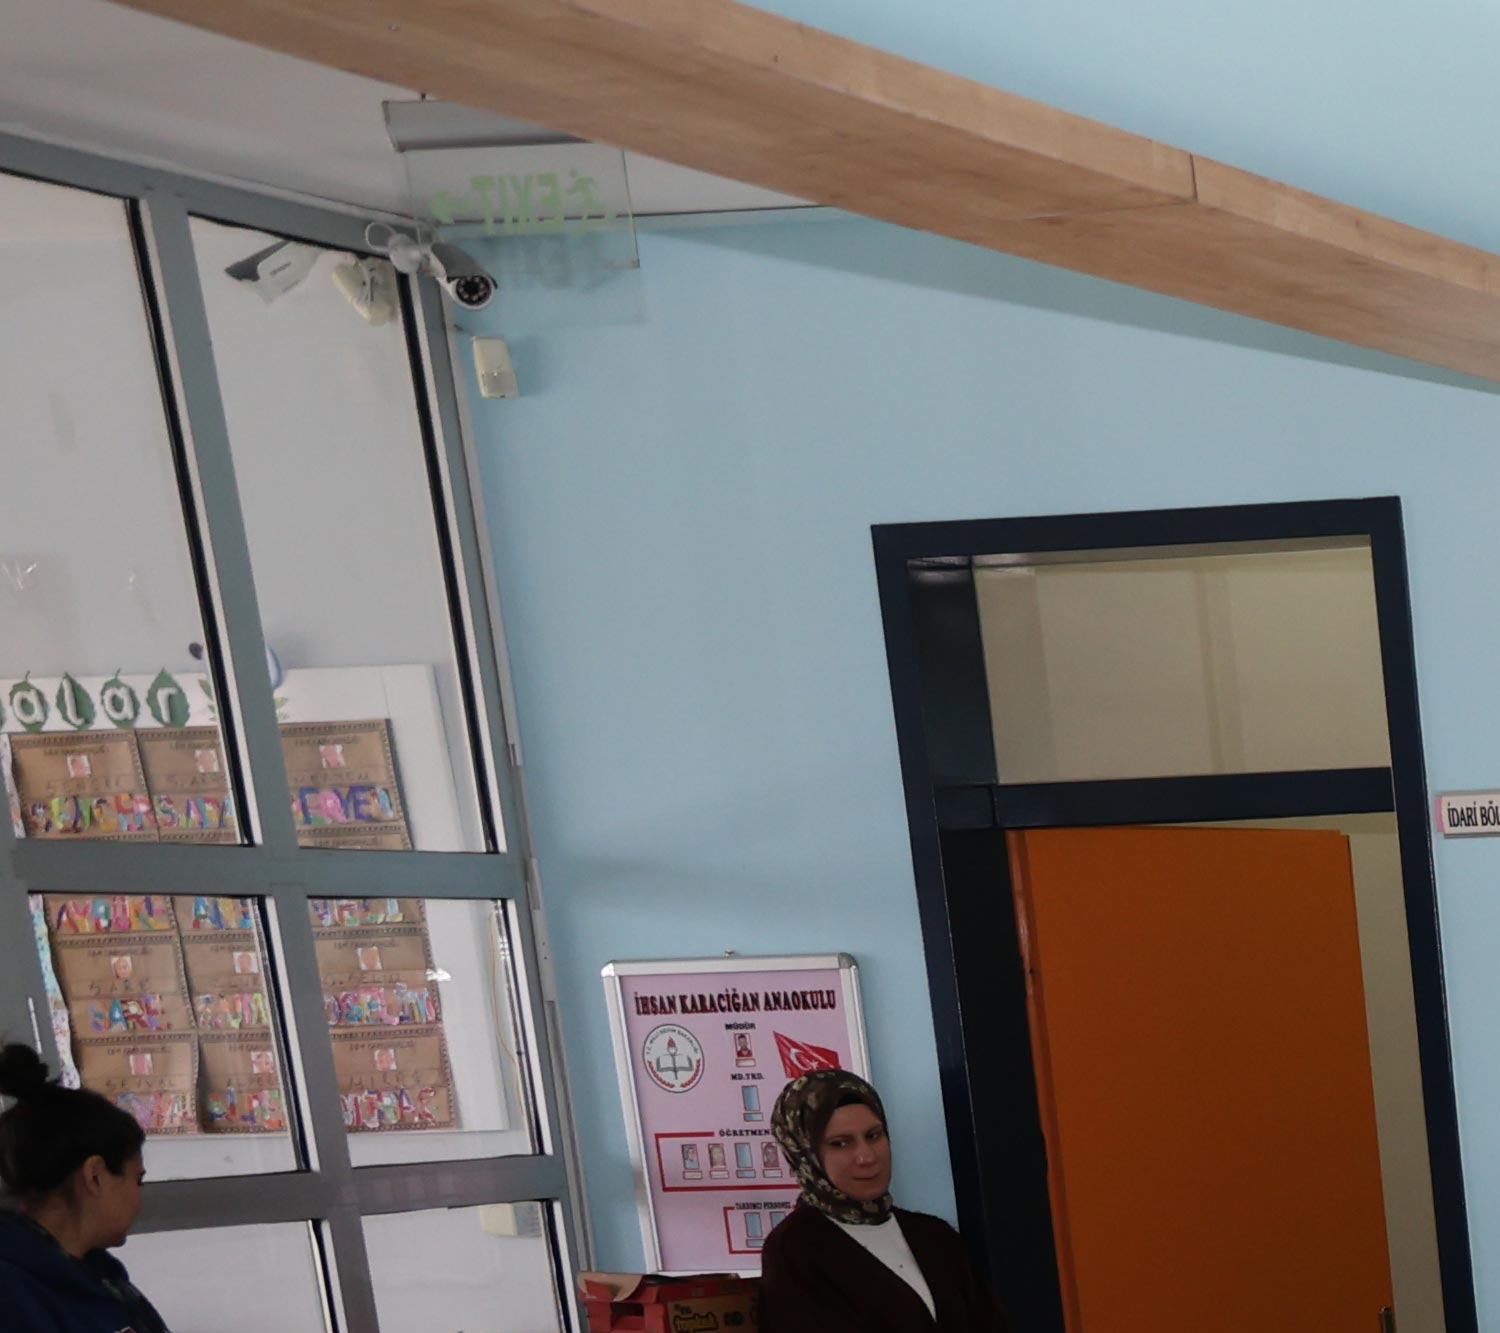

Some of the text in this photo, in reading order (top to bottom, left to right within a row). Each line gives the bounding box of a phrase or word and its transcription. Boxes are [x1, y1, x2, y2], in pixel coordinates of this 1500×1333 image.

[1447, 801, 1478, 828] İDARİ
[633, 987, 837, 1016] İHSAN KARACİĞAN ANAOKULU
